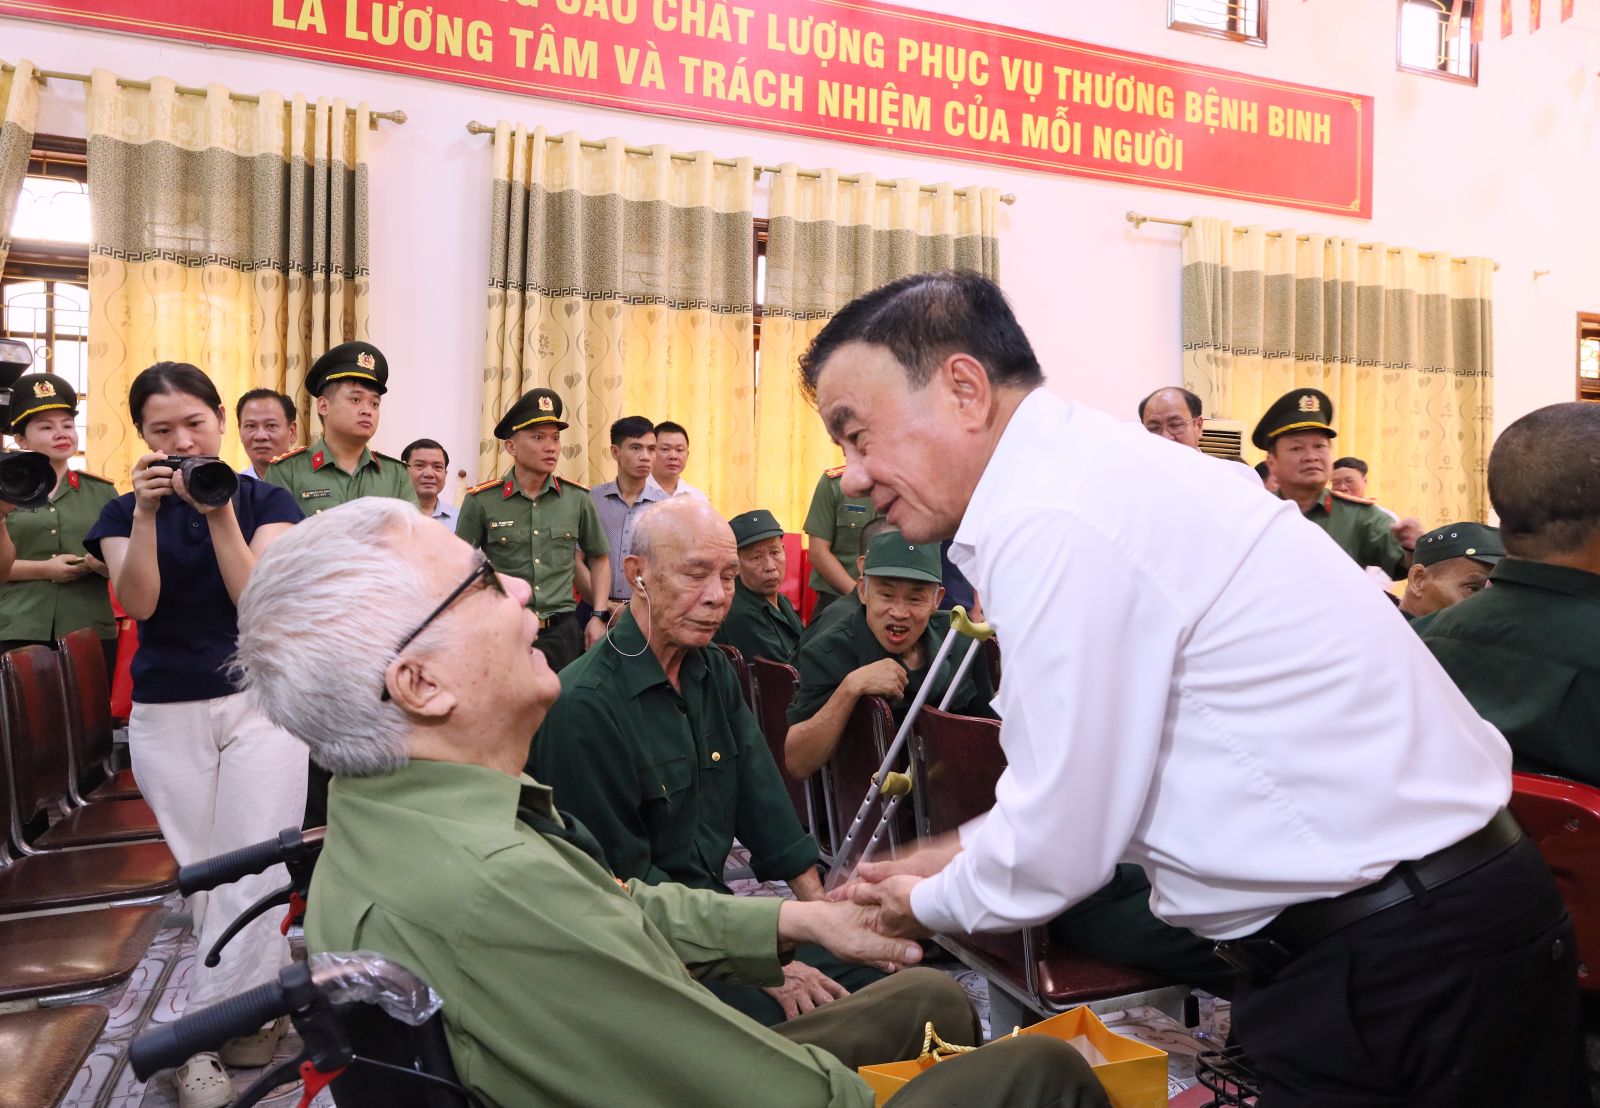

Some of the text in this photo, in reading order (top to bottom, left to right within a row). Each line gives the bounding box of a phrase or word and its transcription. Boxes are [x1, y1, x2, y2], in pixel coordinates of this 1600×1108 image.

[345, 0, 493, 62] LƯƠNG
[509, 23, 598, 80] TÂM
[614, 39, 665, 89] VÀ
[679, 56, 803, 112] TRÁCH
[818, 81, 931, 135] NHIỆM
[943, 94, 1010, 144] CỦA
[1021, 105, 1082, 155] MỖI
[1093, 125, 1183, 172] NGƯỜI
[768, 15, 885, 69] LƯỢNG
[898, 38, 989, 89] PHỤC
[1001, 55, 1043, 103] VỤ
[1054, 65, 1175, 119] THƯƠNG
[1185, 86, 1259, 134] BỆNH
[1268, 105, 1331, 145] BINH
